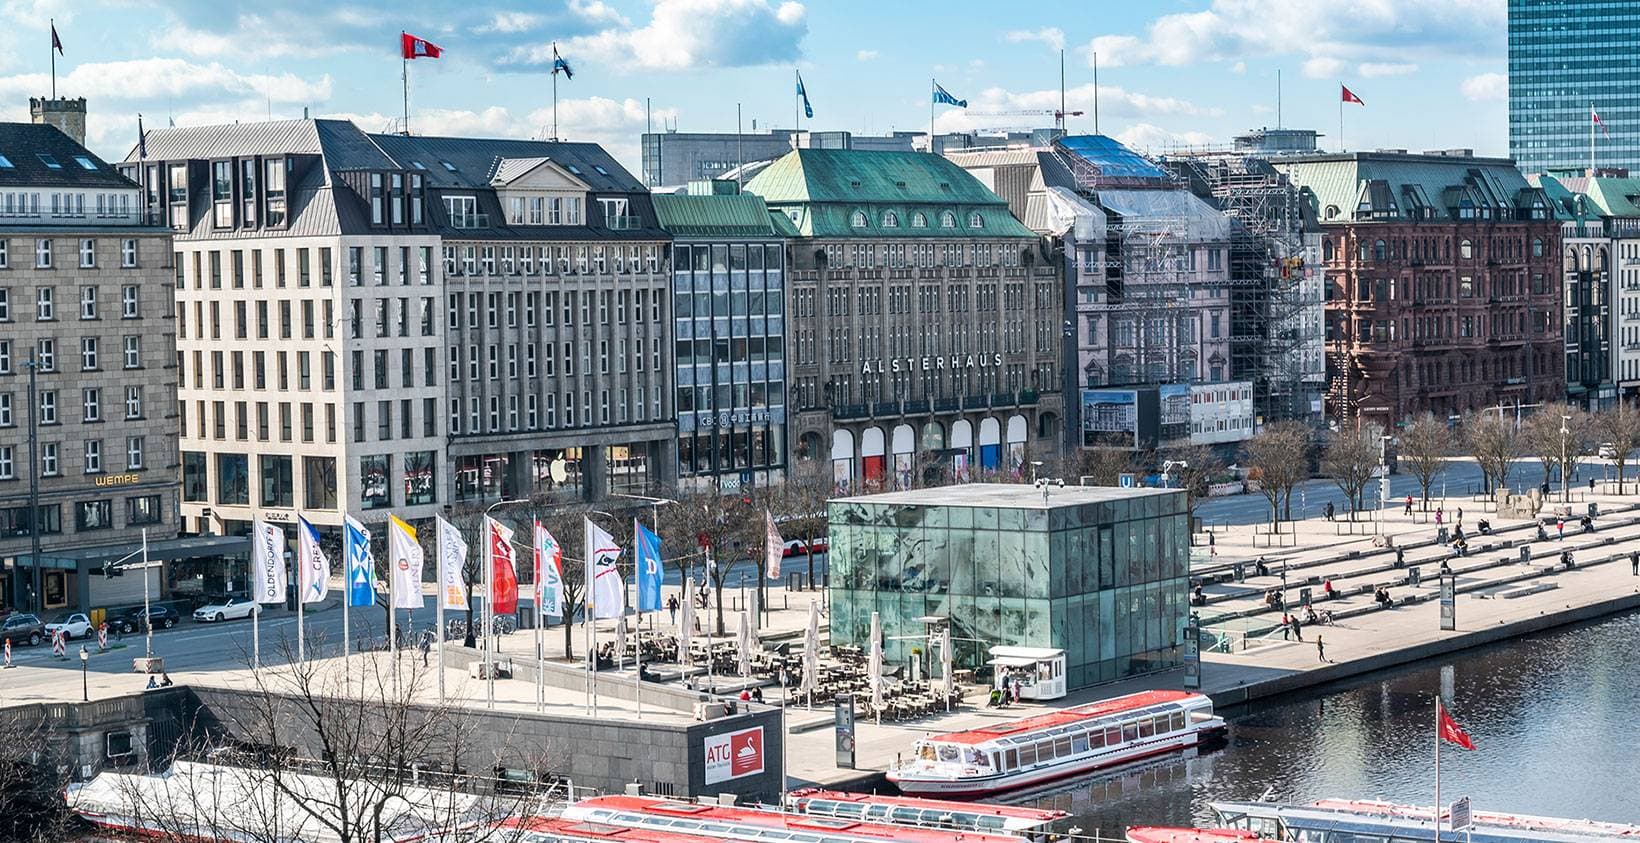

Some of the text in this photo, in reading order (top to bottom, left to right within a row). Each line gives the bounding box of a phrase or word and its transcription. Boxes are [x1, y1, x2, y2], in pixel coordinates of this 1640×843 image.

[861, 353, 1002, 374] ALSTERHAUS
[95, 474, 139, 487] WEMPE
[1121, 476, 1131, 488] U
[706, 743, 731, 764] ATG
